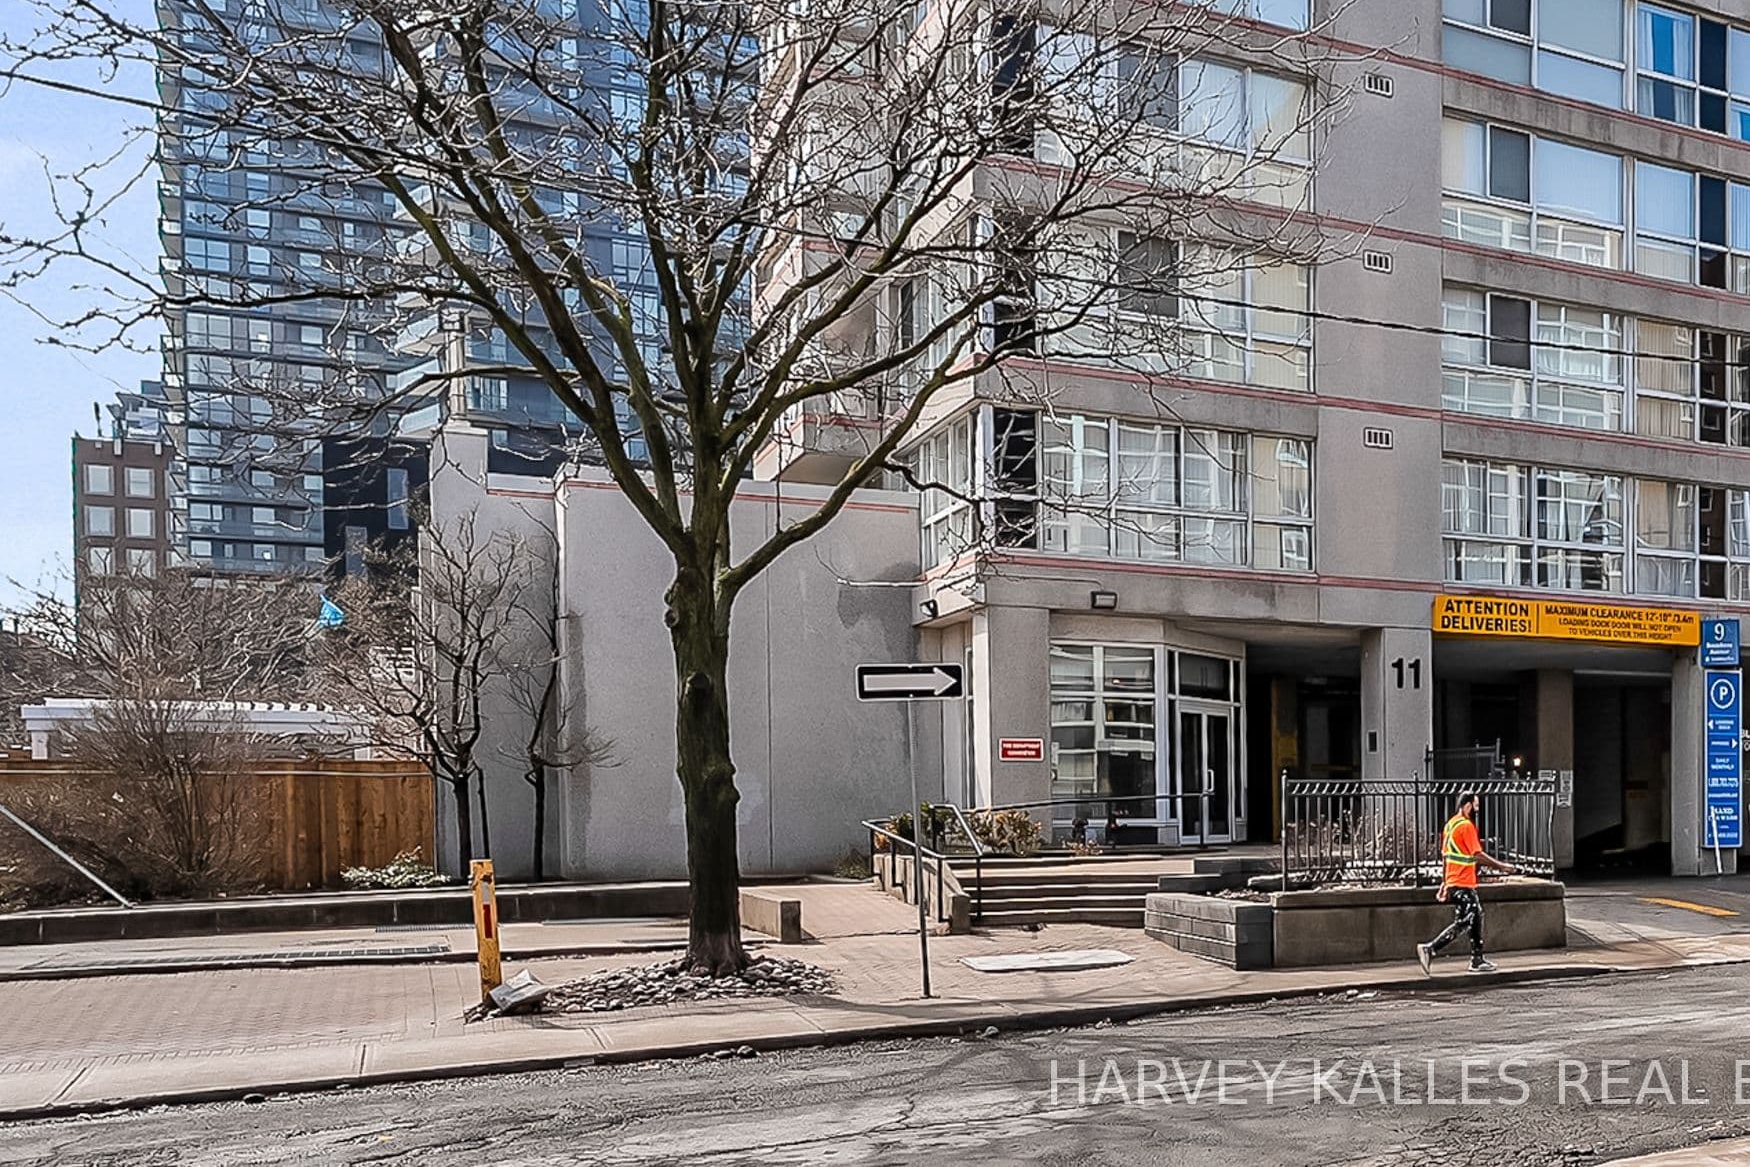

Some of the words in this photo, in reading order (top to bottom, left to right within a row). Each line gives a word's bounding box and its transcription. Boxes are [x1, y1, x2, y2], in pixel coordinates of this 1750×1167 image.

[1444, 598, 1530, 617] ATTENTION
[1545, 605, 1589, 617] MAXIMUM
[1589, 608, 1643, 621] CLEARANCE
[1441, 615, 1533, 633] DELIVERIES!
[1558, 617, 1590, 627] LOADING
[1663, 624, 1682, 632] OPEN
[1568, 627, 1578, 635] TO
[1579, 628, 1612, 638] VEHICLES
[1713, 622, 1725, 642] 9
[1391, 657, 1421, 689] 11
[1719, 686, 1729, 701] P
